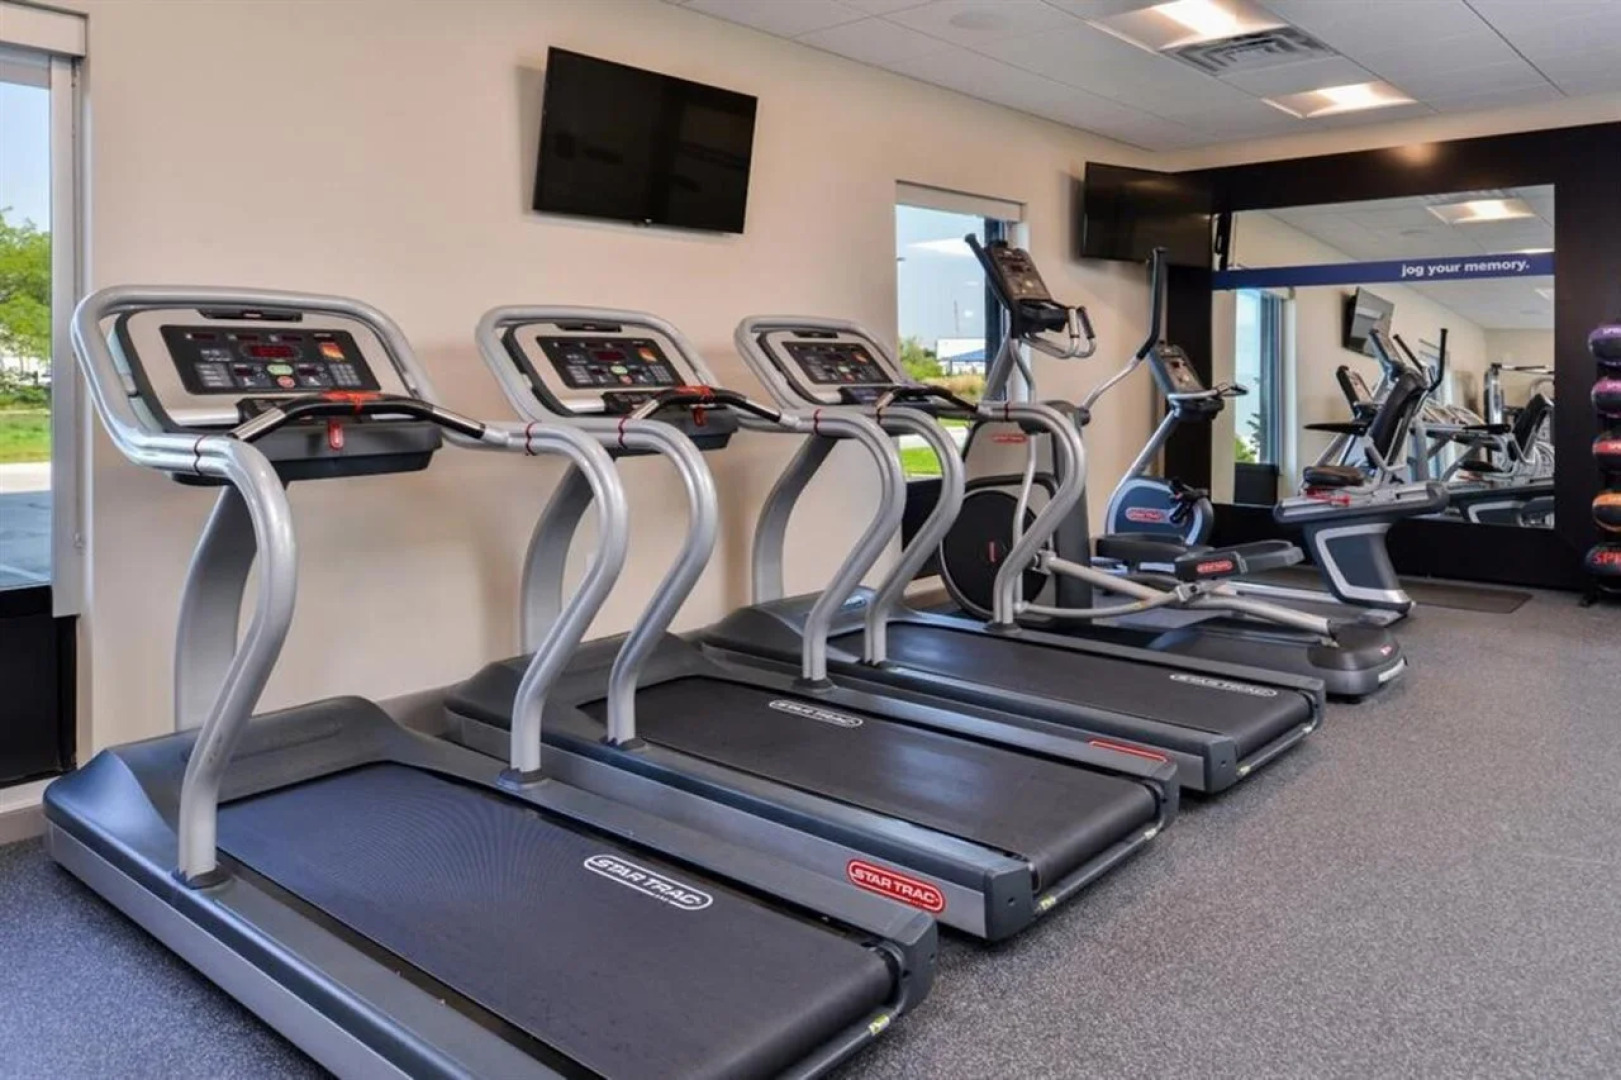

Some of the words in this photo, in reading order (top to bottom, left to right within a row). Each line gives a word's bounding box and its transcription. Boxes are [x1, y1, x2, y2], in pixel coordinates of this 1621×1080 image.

[1401, 263, 1425, 278] jog
[1428, 263, 1461, 277] your
[1464, 260, 1530, 273] memory.
[590, 858, 647, 882] STAR
[643, 878, 702, 905] TRAC
[851, 868, 893, 890] STAR
[893, 881, 938, 904] TRAC
